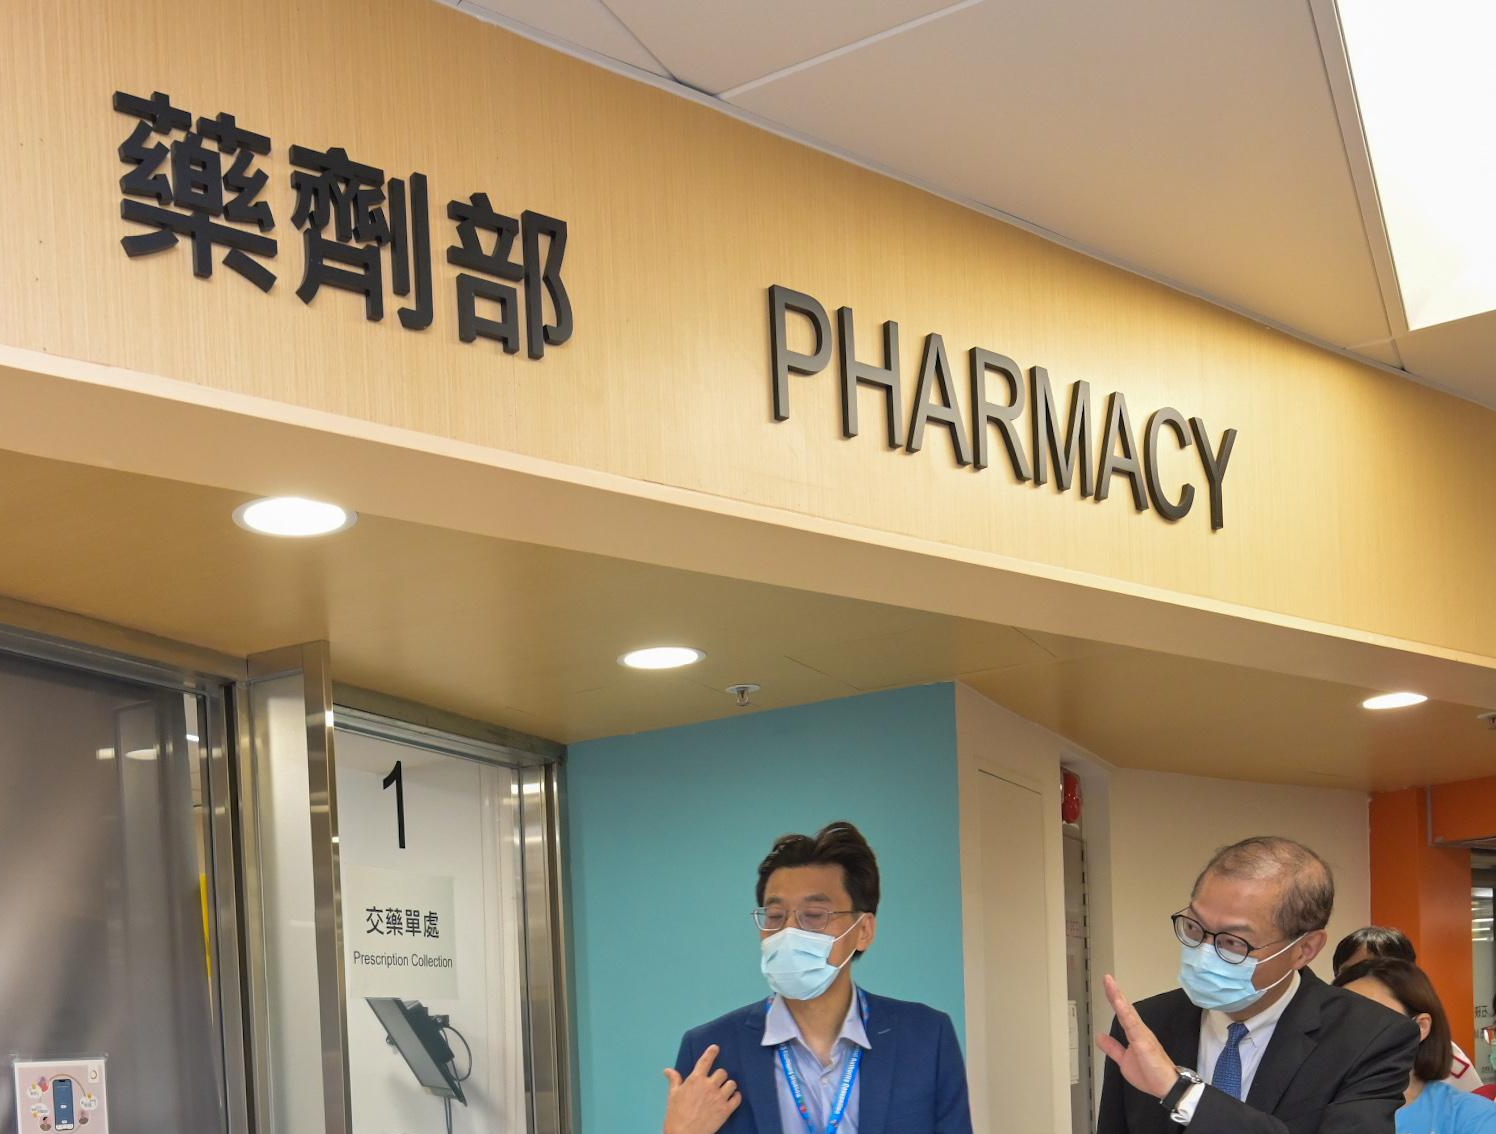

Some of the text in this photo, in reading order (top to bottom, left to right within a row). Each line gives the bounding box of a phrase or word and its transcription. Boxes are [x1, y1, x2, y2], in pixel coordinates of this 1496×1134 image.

[111, 89, 574, 362] 藥劑部
[767, 284, 1238, 532] PHARMACY
[382, 760, 406, 849] 1
[353, 950, 453, 968] Prescription Collection
[365, 905, 440, 939] 交藥單處
